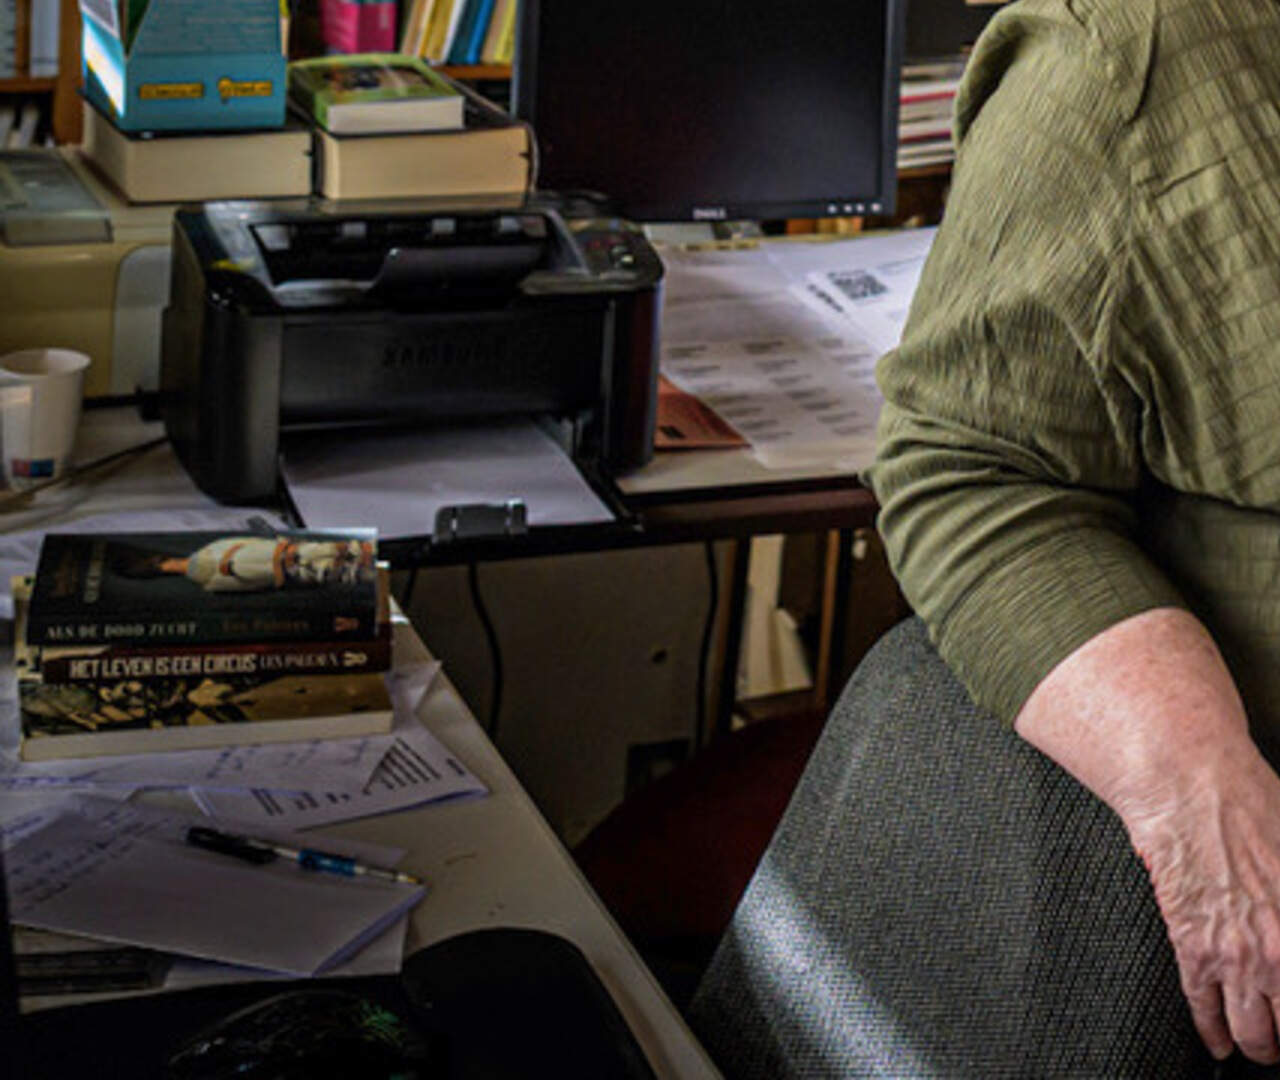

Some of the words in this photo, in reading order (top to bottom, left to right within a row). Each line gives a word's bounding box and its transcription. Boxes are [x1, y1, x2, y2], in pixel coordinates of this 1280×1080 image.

[69, 659, 99, 679] HET
[102, 657, 153, 678] LEVEN
[155, 656, 170, 676] IS
[171, 655, 201, 676] EEN
[204, 653, 258, 674] CIRCUS
